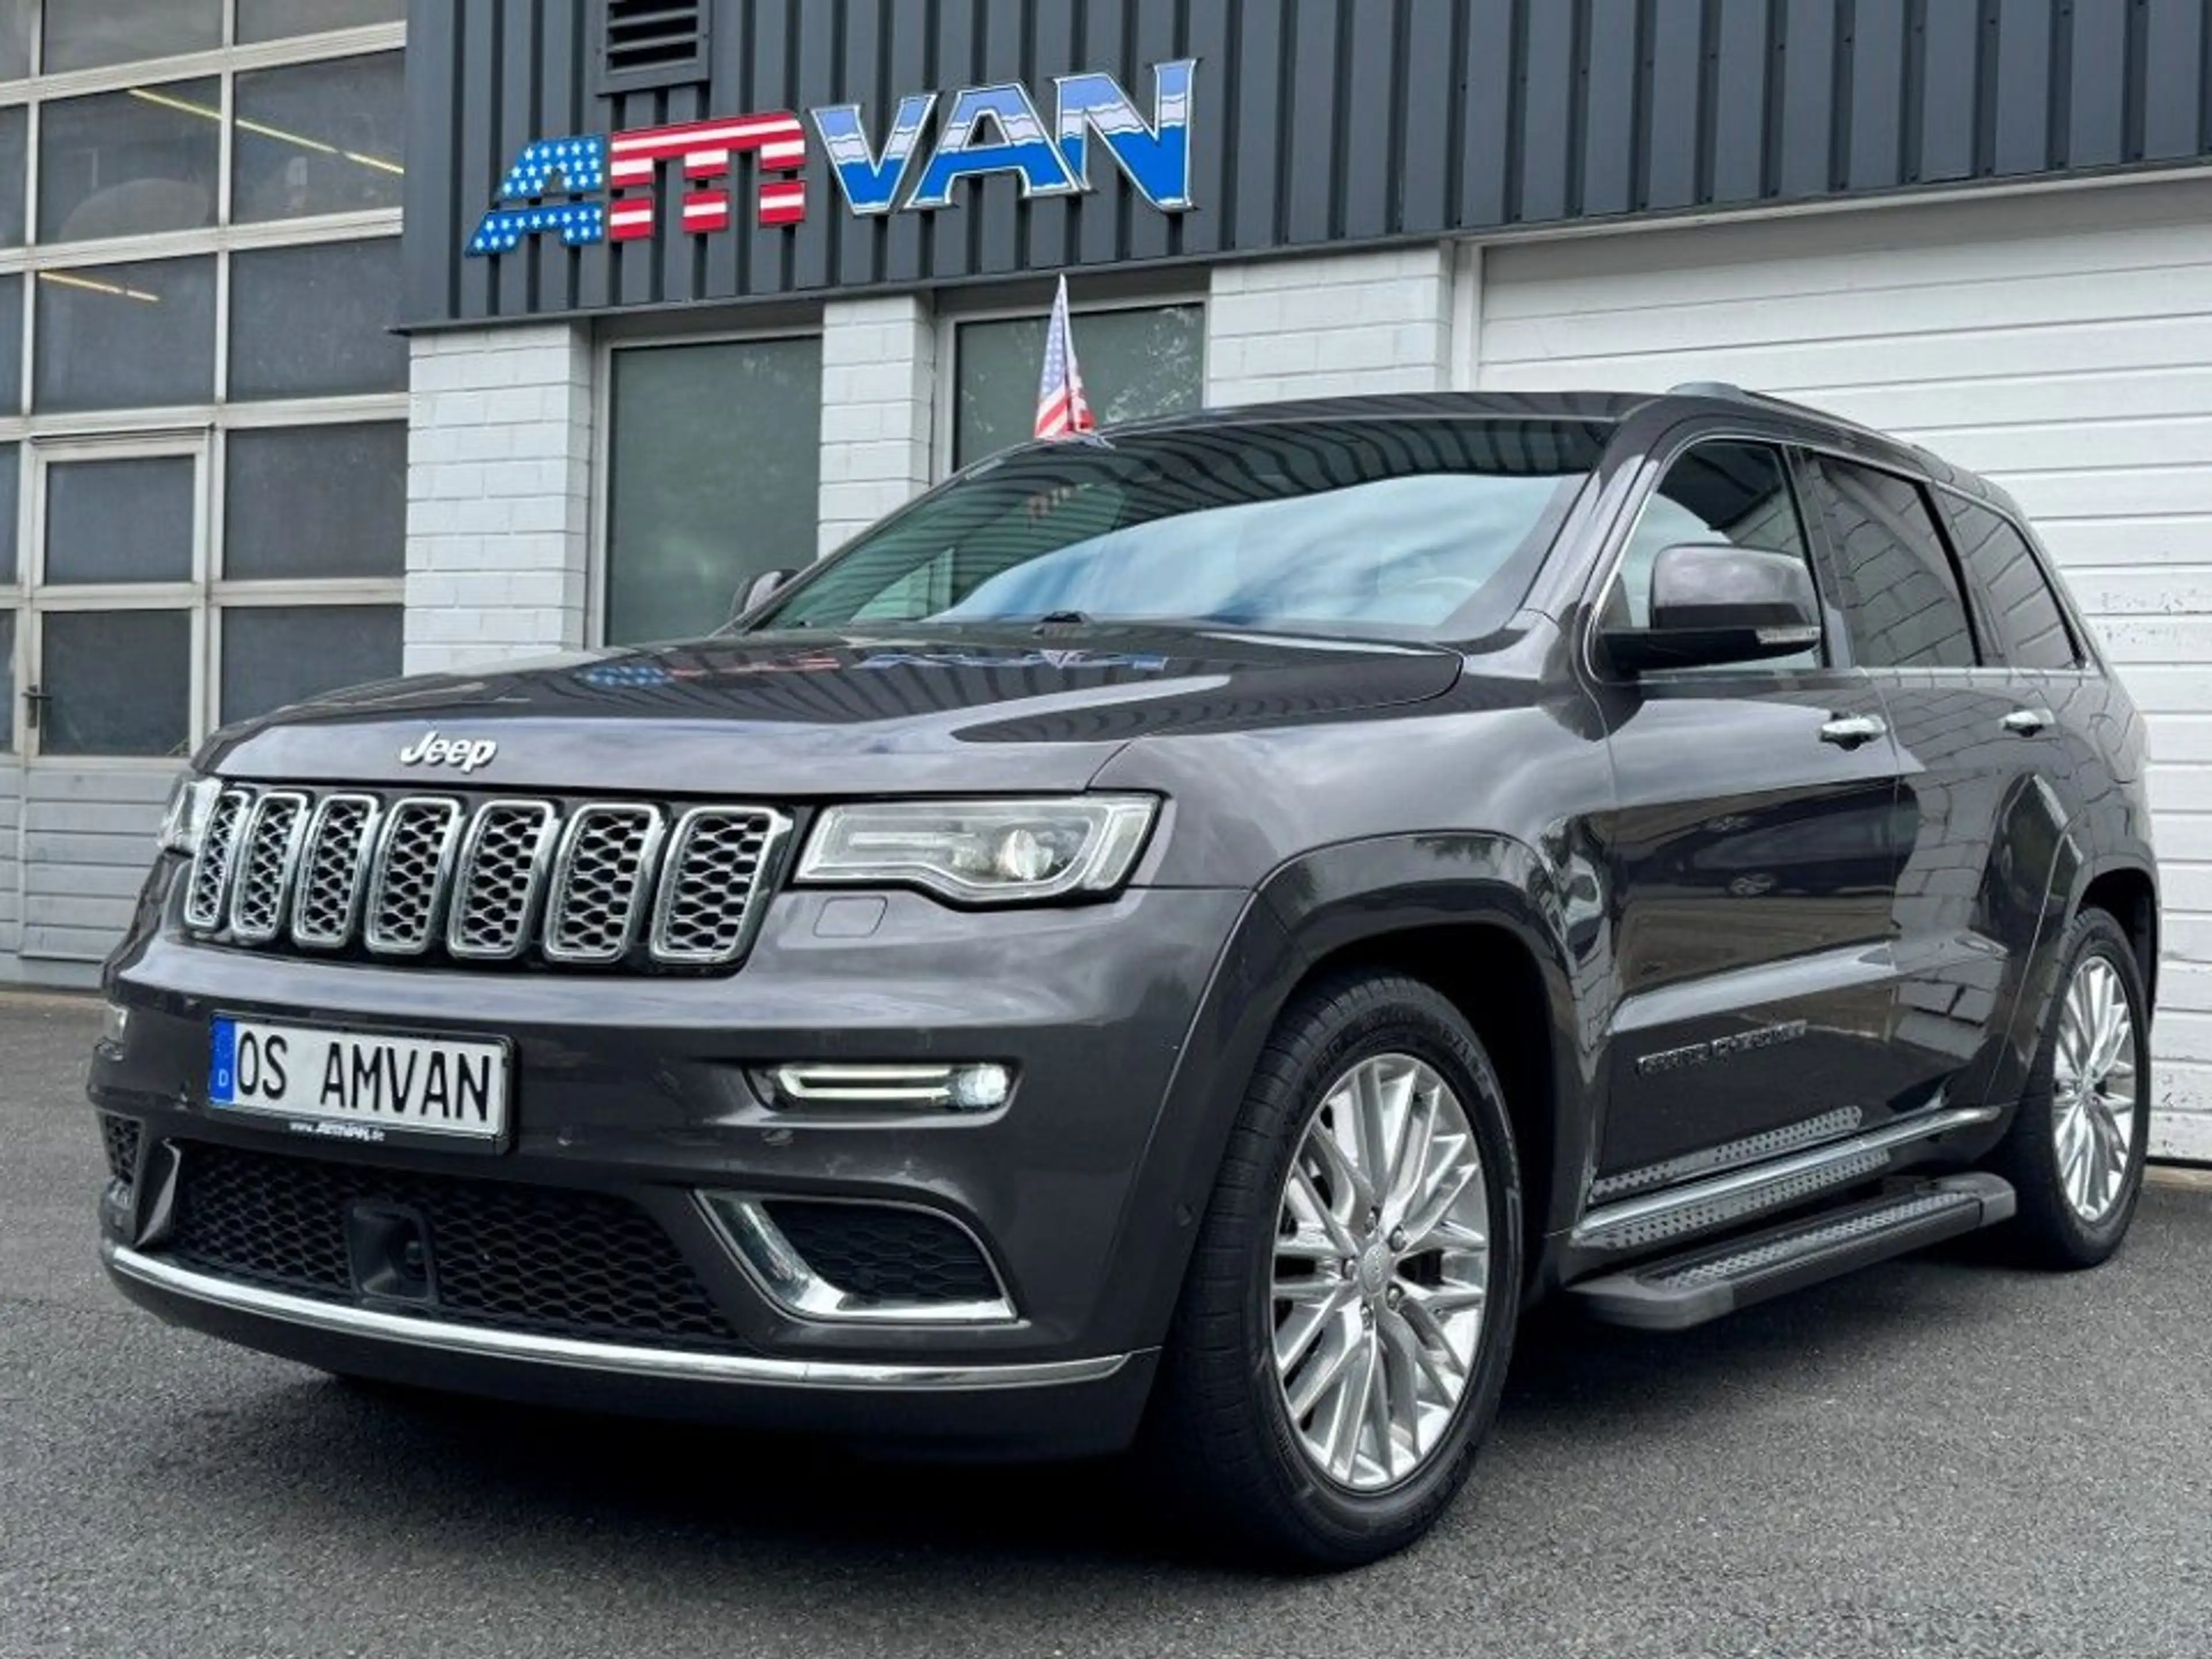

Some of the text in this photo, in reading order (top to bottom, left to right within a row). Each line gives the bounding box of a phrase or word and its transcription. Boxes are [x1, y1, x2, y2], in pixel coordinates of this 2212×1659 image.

[400, 730, 498, 772] Jeep
[217, 1069, 229, 1086] D
[237, 1031, 491, 1121] OS AMVAN
